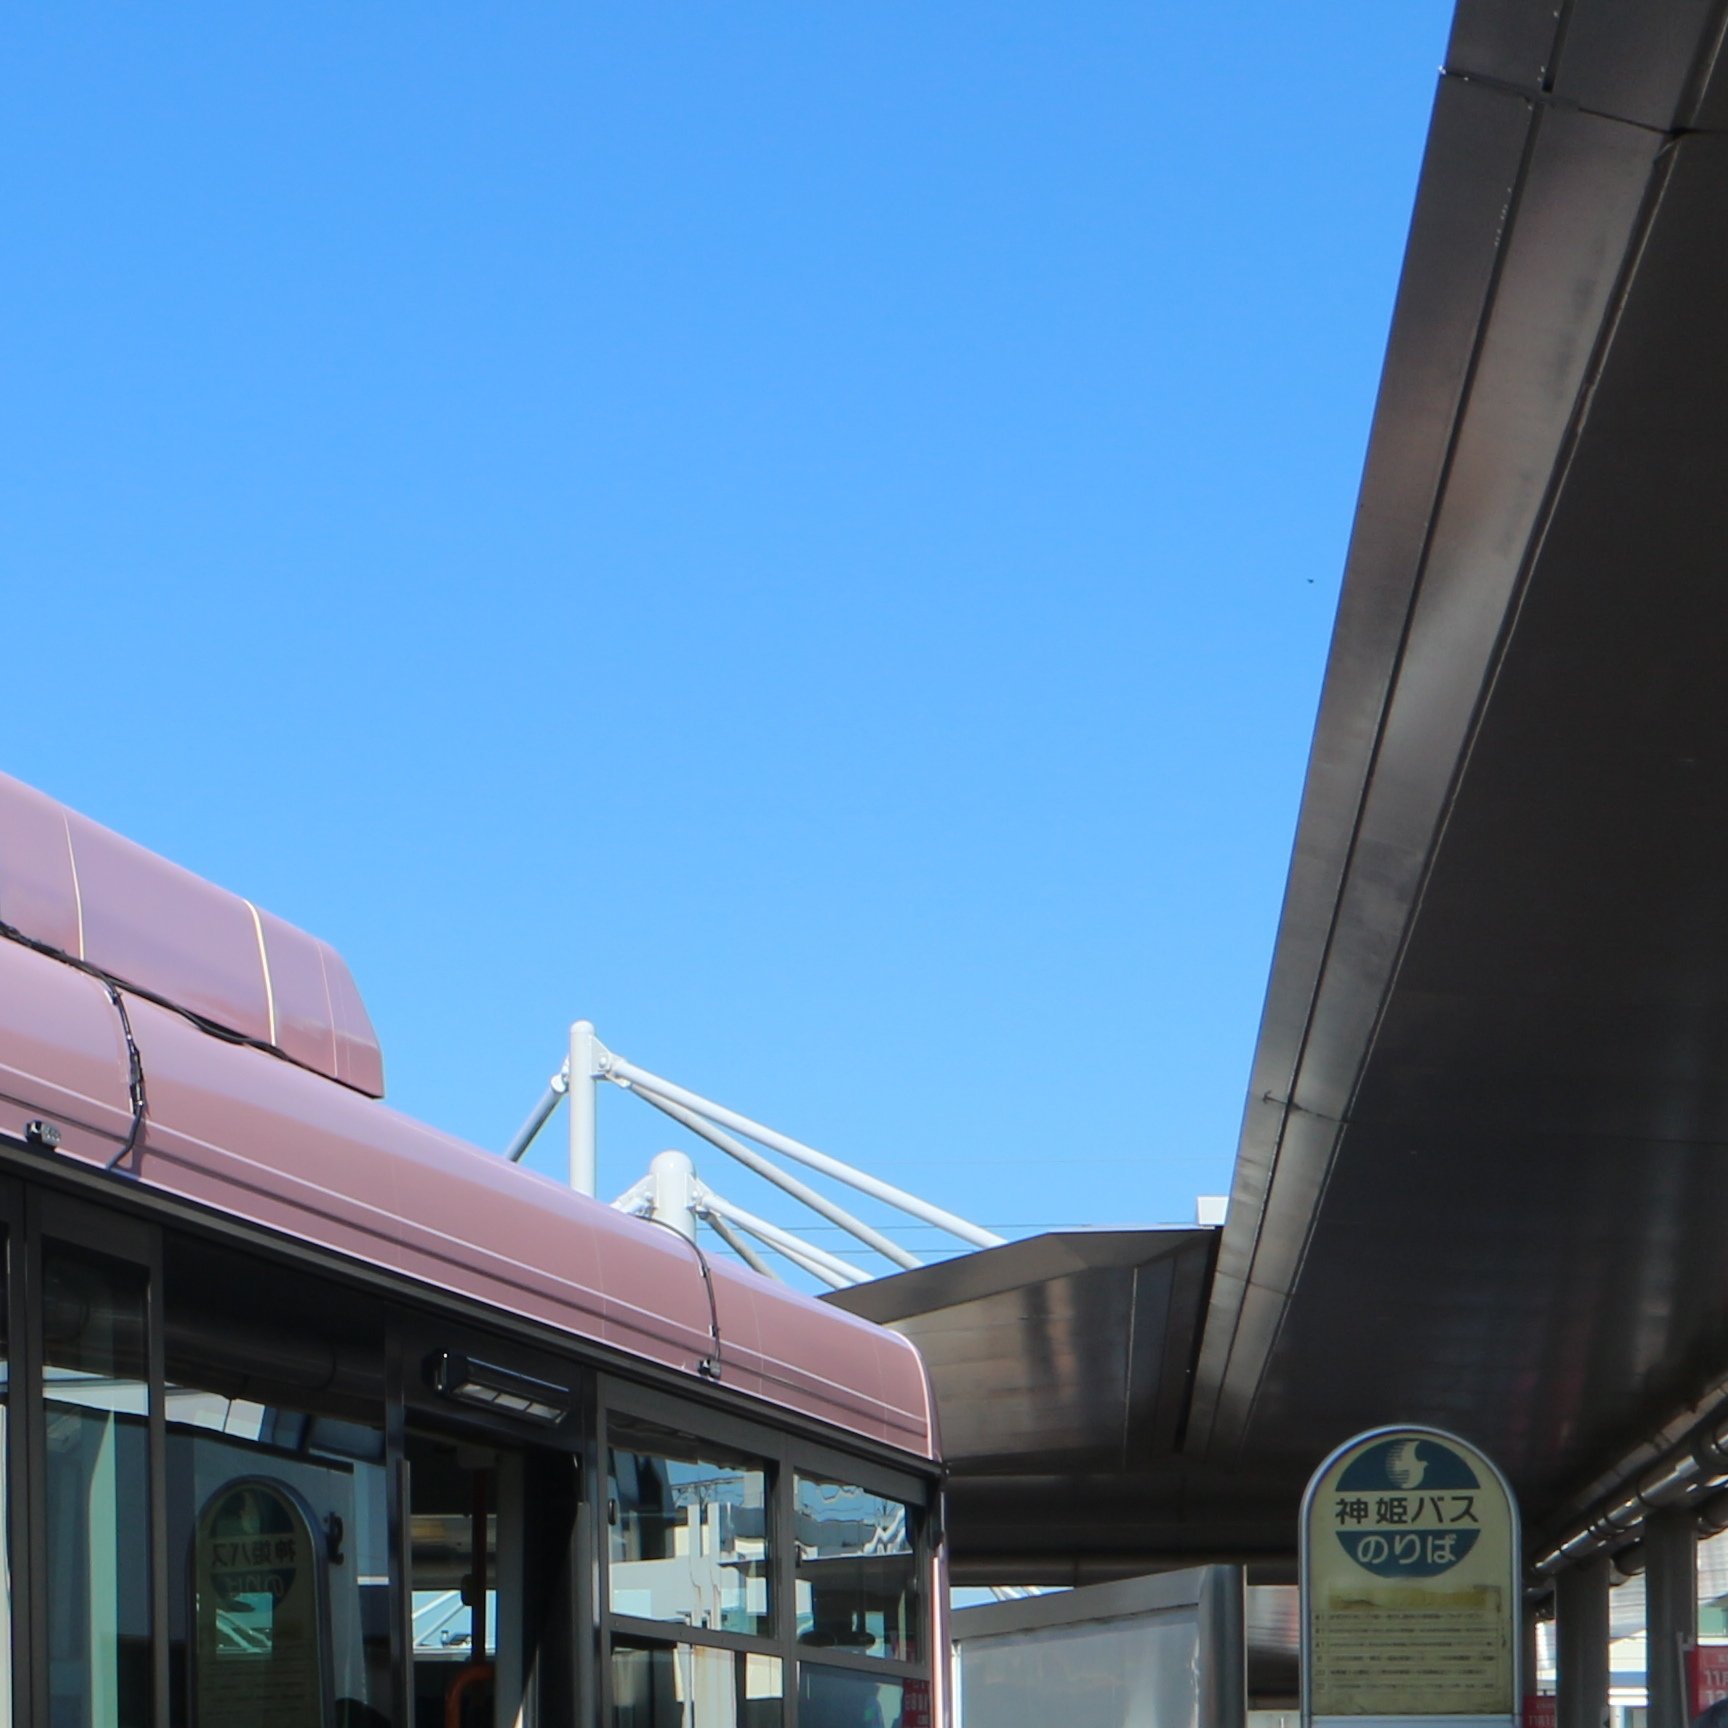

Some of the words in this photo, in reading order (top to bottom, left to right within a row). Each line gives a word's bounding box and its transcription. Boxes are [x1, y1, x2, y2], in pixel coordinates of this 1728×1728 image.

[1335, 1495, 1480, 1526] 神姫バス
[1356, 1533, 1458, 1565] のりば
